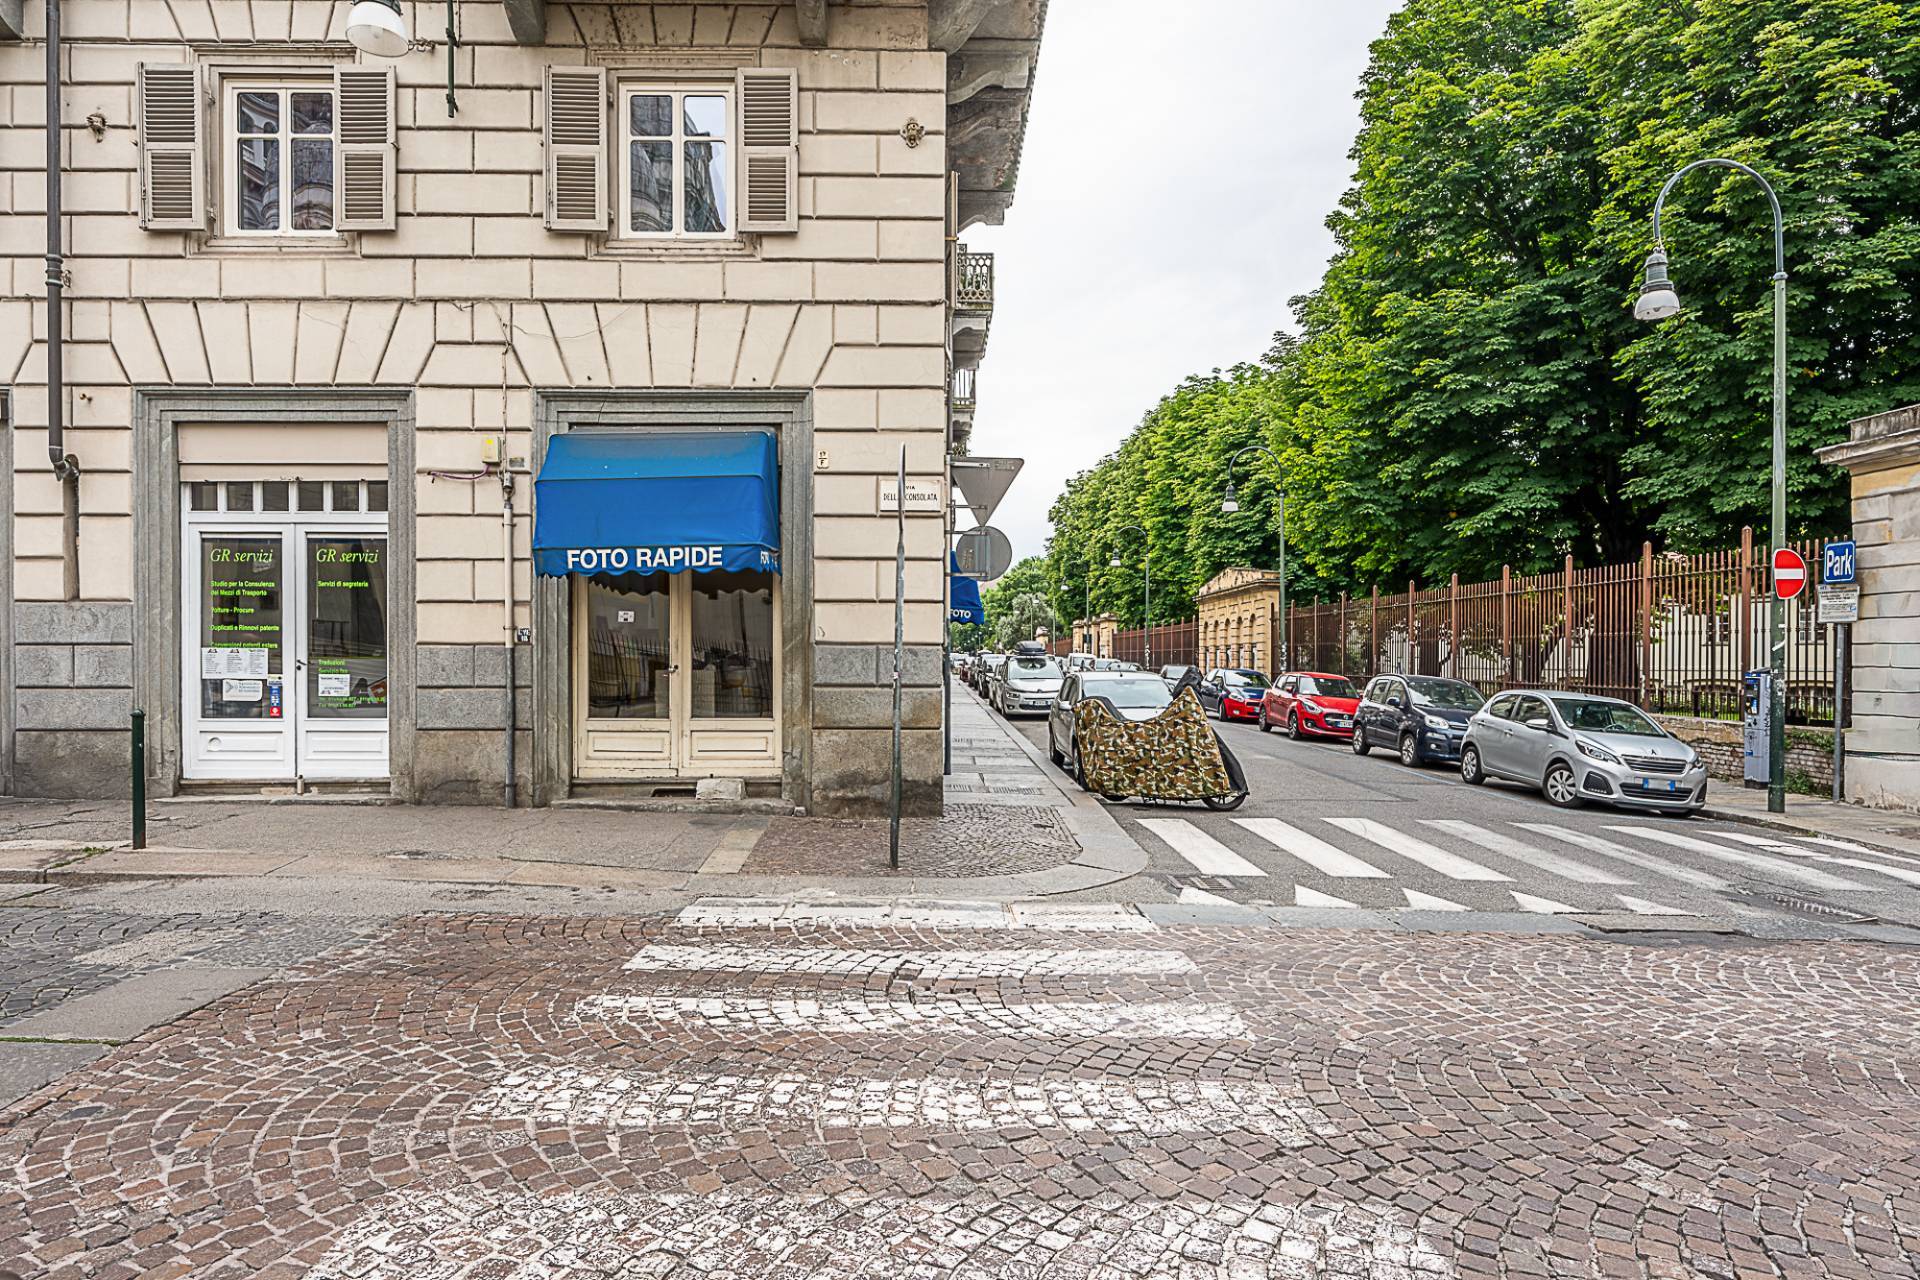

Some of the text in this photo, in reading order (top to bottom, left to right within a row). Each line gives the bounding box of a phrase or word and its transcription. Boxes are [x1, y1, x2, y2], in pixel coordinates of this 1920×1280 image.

[883, 492, 938, 501] DELL CONSOLATA
[210, 548, 273, 563] GR servizi
[316, 548, 379, 563] GR servizi
[566, 546, 722, 569] FOTO RAPIDE
[1826, 548, 1853, 577] Park
[342, 581, 369, 589] segreteria
